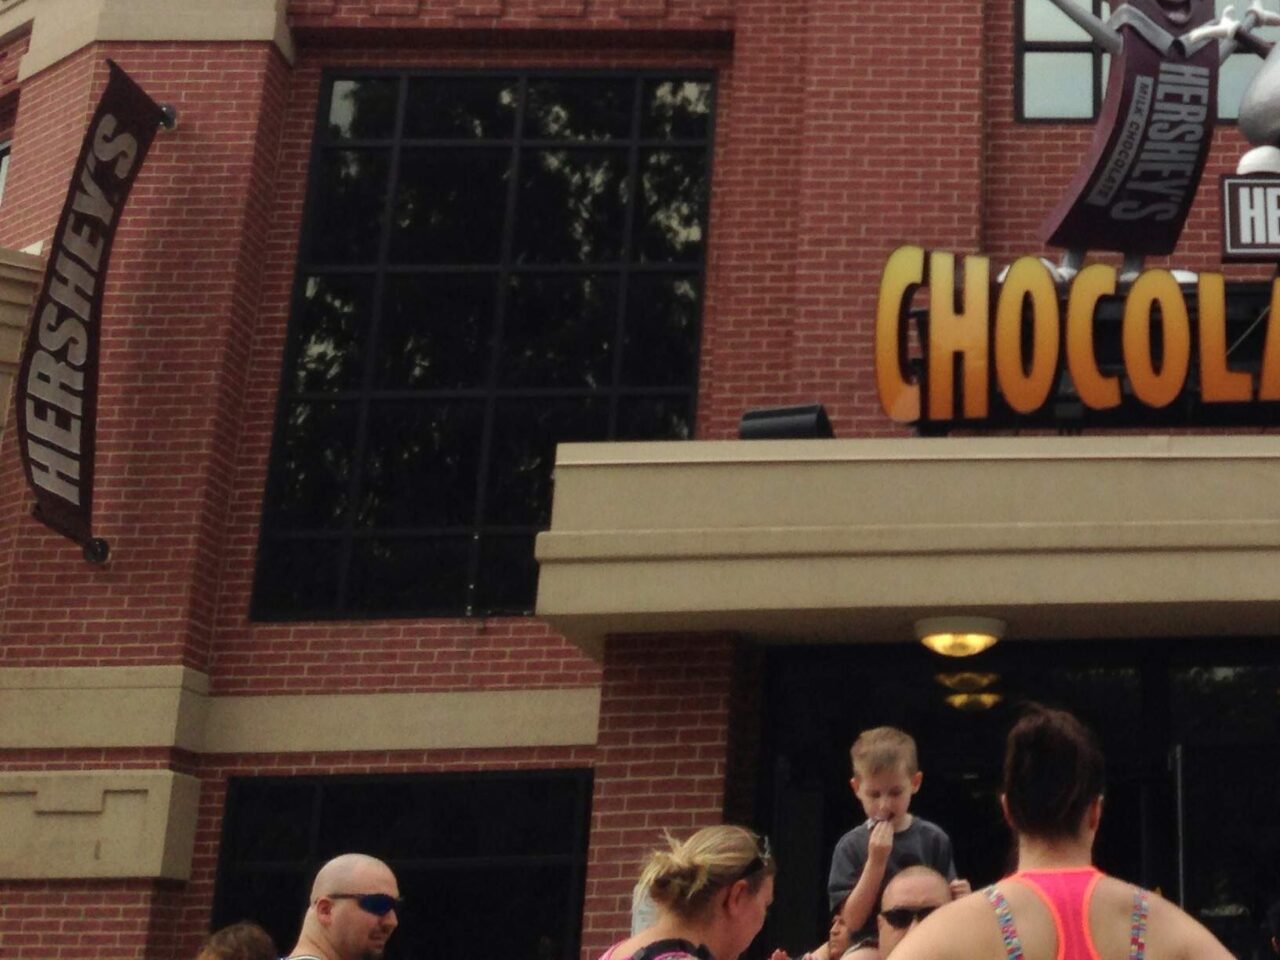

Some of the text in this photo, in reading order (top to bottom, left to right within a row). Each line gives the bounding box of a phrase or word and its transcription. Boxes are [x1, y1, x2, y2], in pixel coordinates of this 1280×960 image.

[1111, 62, 1210, 221] HERSHEY'S
[1134, 83, 1149, 117] MILK
[27, 113, 139, 505] HERSHEY'S
